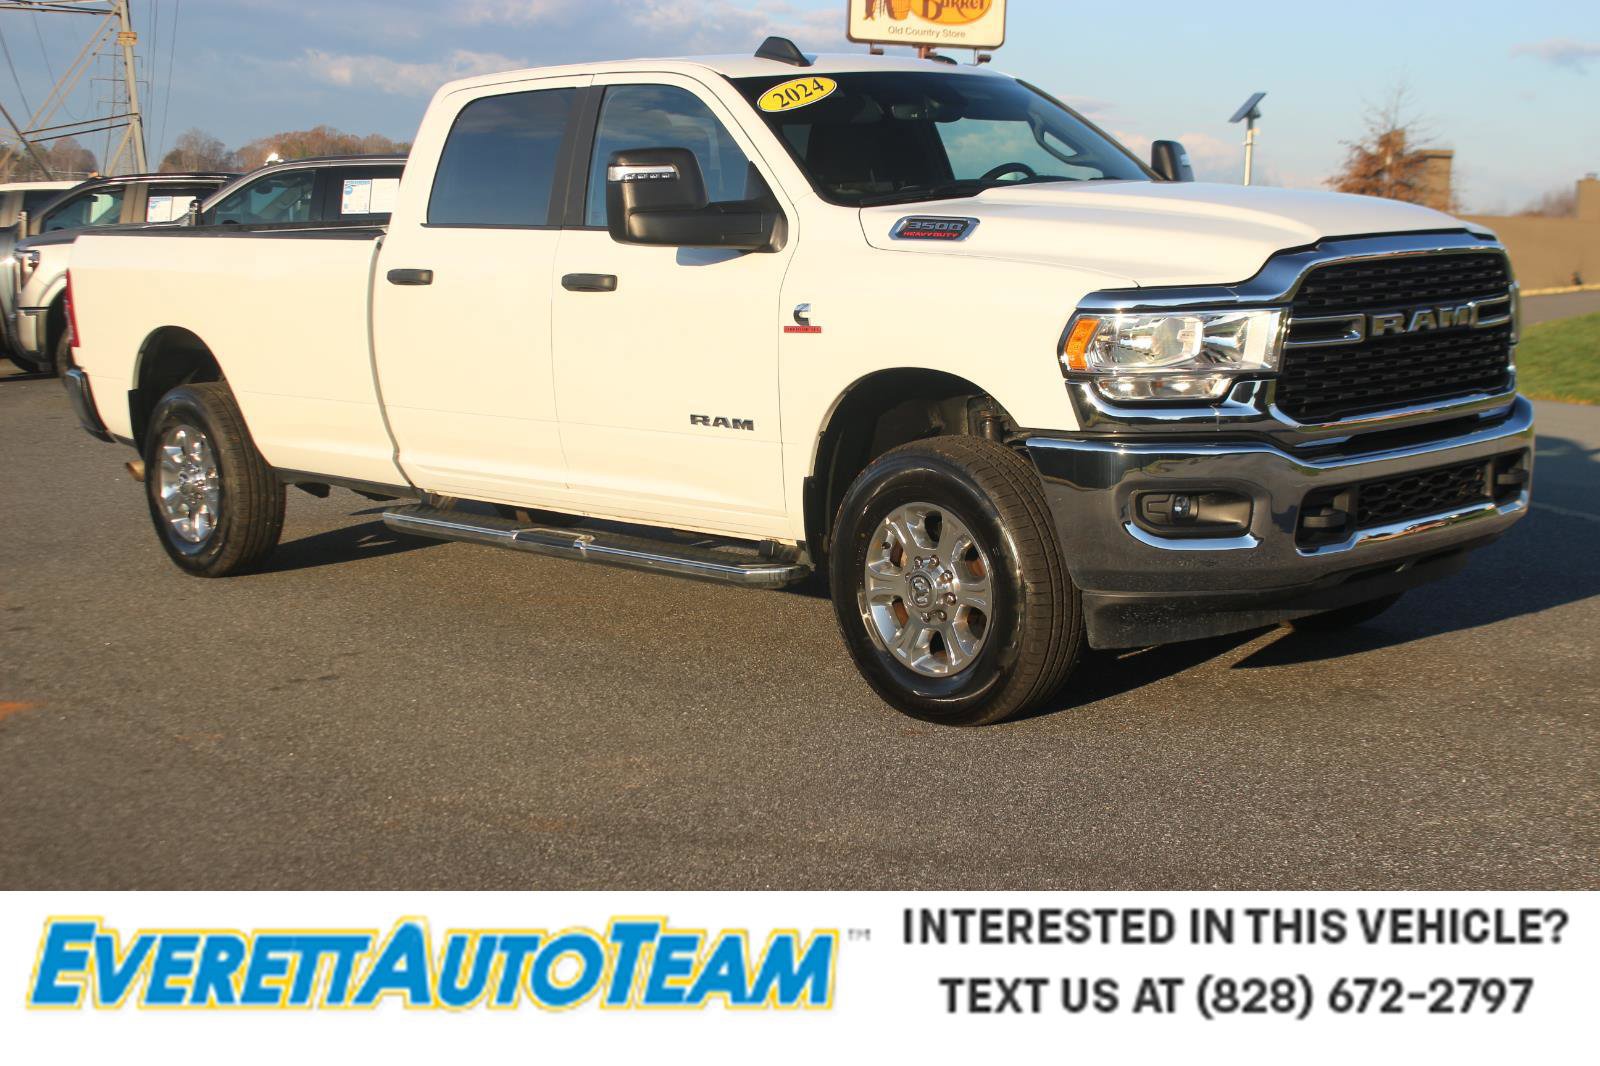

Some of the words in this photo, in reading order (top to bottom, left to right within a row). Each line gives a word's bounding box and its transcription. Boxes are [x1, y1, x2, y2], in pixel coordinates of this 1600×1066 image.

[888, 25, 903, 34] Old
[905, 26, 941, 38] Country
[942, 28, 966, 38] Store
[772, 77, 825, 109] 2024
[907, 221, 964, 231] 3500
[1372, 304, 1471, 336] RAM
[690, 414, 754, 431] RAM
